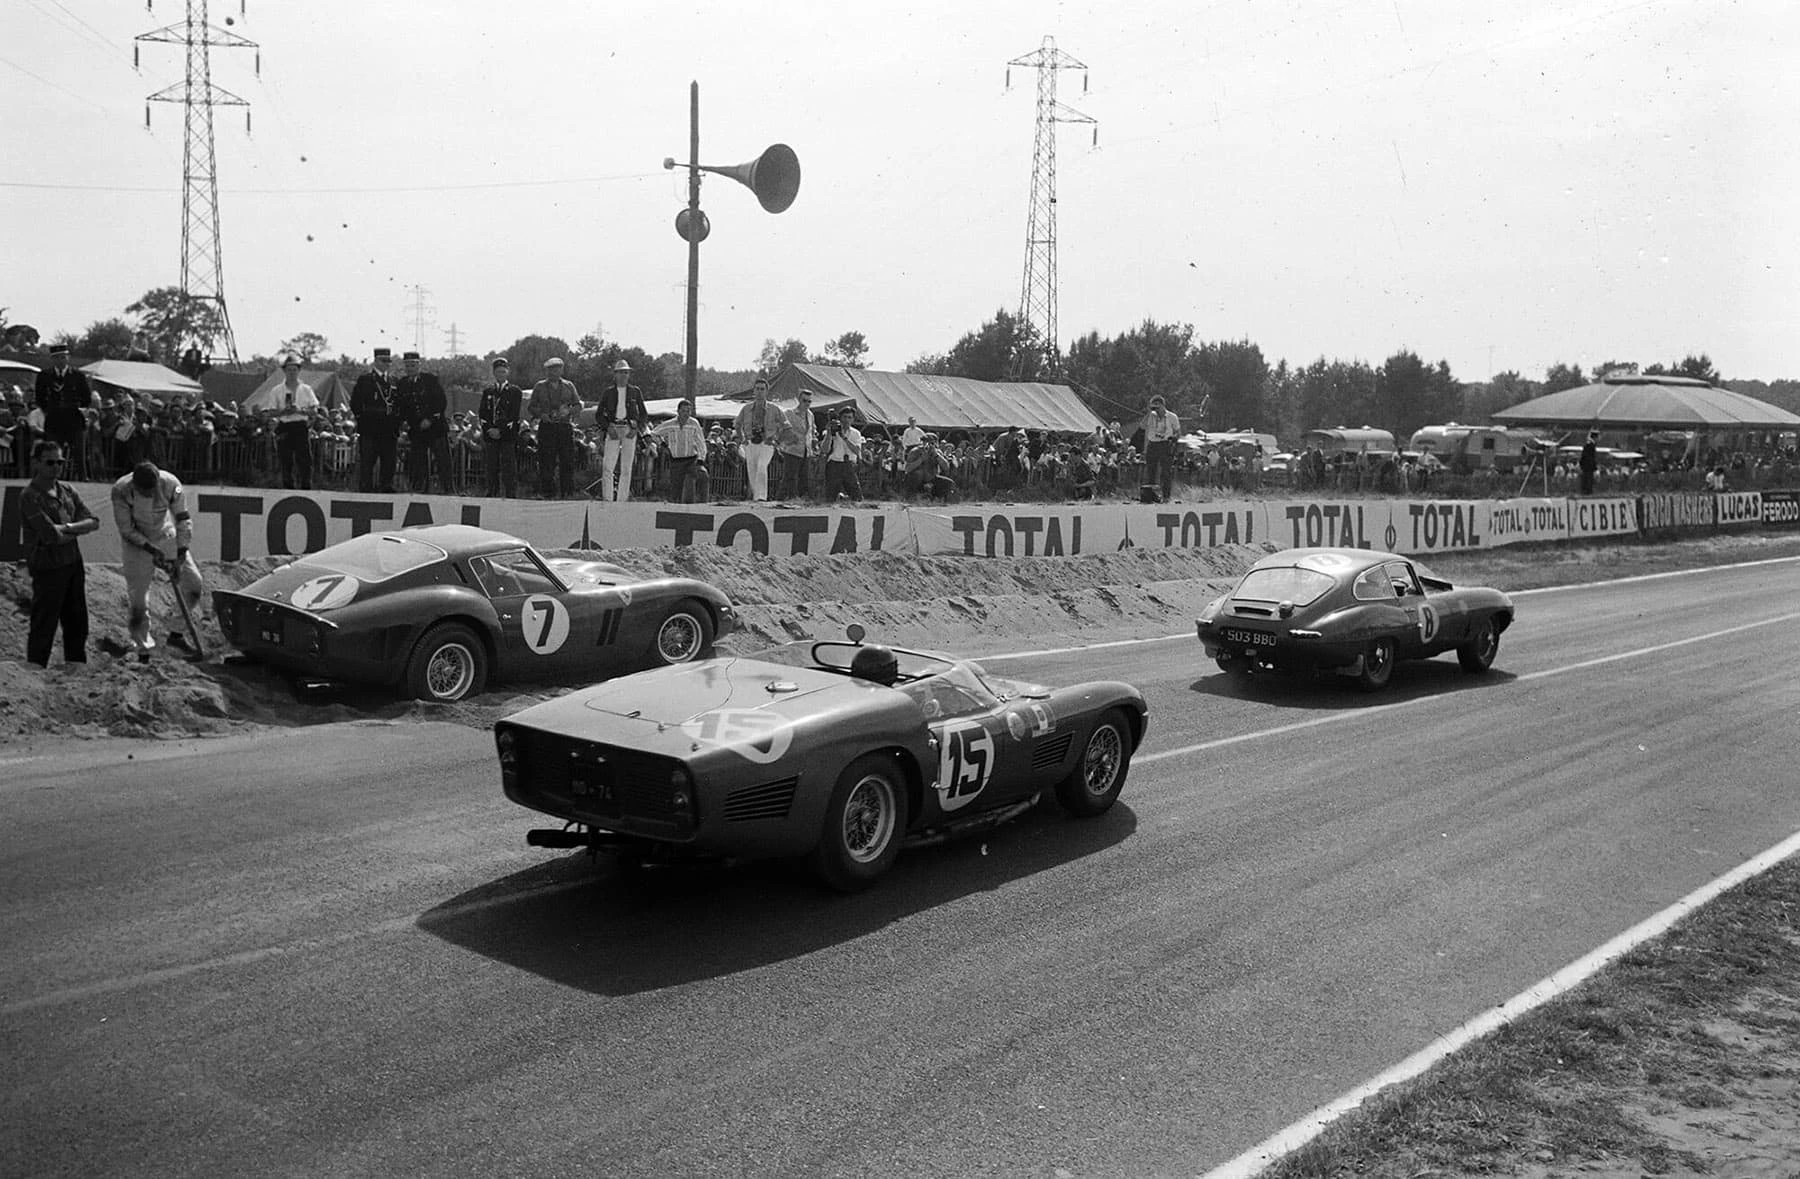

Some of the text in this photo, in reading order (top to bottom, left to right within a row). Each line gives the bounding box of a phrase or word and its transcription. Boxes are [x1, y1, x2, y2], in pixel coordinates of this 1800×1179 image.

[1493, 506, 1565, 536] TOTAL TOTAL
[1721, 495, 1759, 520] LUCAS
[1763, 501, 1799, 522] FERODO
[1286, 504, 1480, 550] TOTAL TOTAL
[308, 575, 346, 605] 7
[532, 601, 555, 648] 7
[1227, 629, 1251, 644] 503
[946, 726, 987, 800] 15
